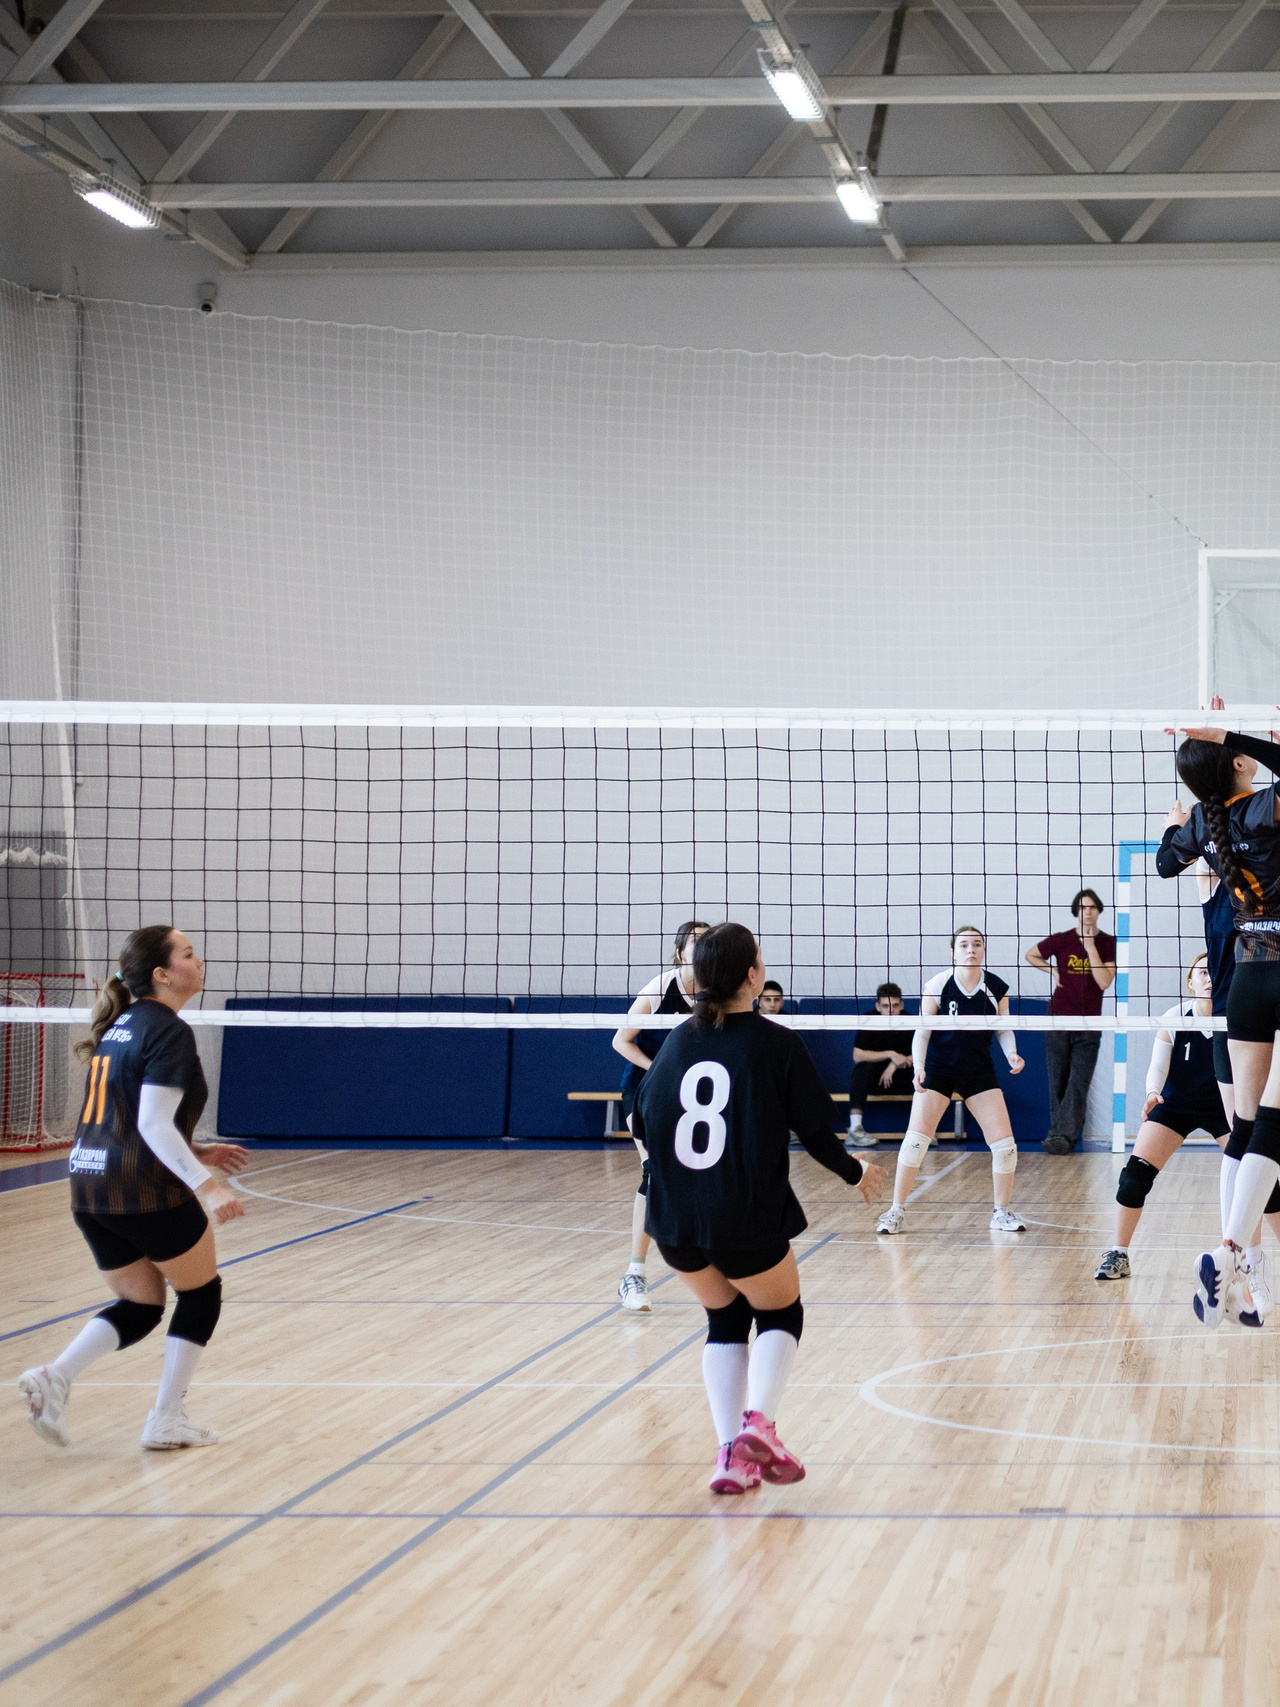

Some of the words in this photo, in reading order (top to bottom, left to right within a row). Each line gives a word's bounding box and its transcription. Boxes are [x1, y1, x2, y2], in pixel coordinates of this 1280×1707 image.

[948, 1001, 958, 1016] 8
[1184, 1041, 1191, 1061] 1
[82, 1055, 111, 1125] 11
[674, 1060, 731, 1170] 8
